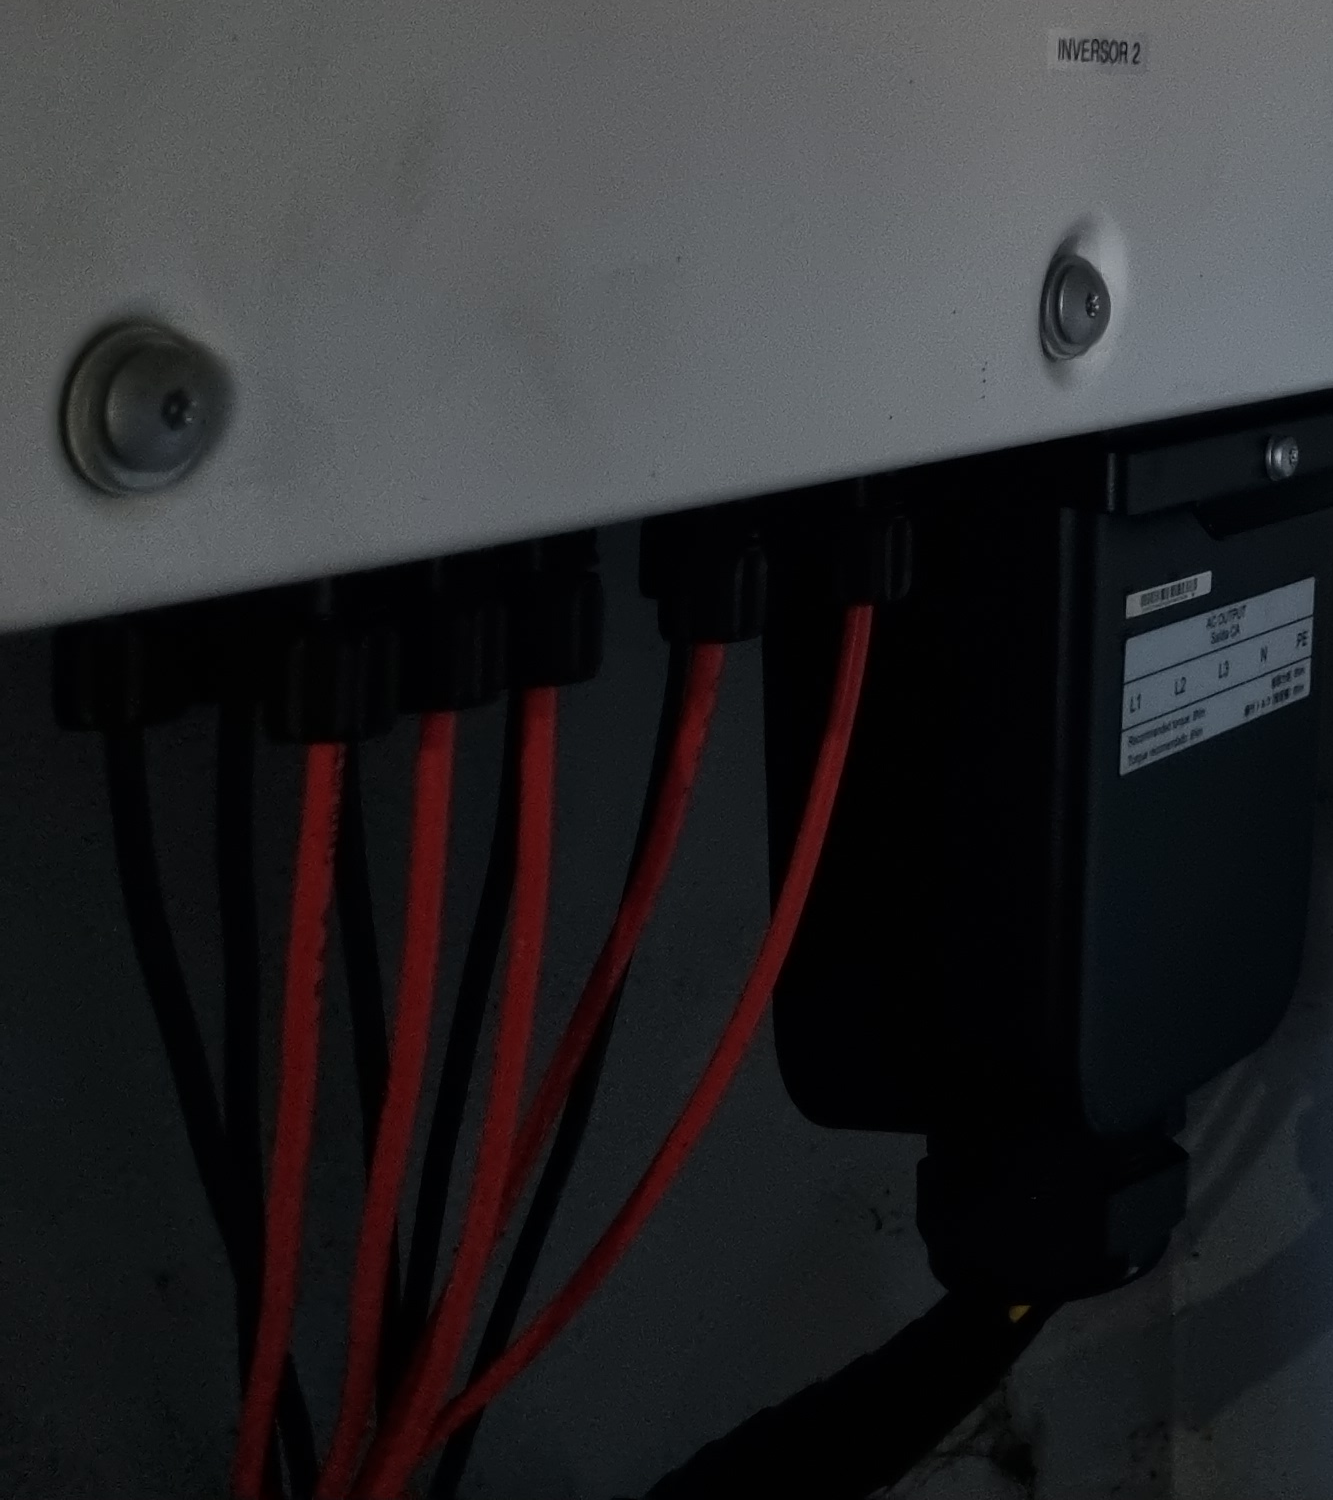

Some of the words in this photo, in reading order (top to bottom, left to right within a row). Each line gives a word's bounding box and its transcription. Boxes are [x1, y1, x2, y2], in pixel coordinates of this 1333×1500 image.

[1057, 37, 1128, 64] INVERSOR
[1132, 42, 1141, 65] 2
[1129, 693, 1142, 713] L1
[1174, 676, 1187, 696] L2
[1218, 660, 1230, 679] L3
[1260, 645, 1268, 663] N
